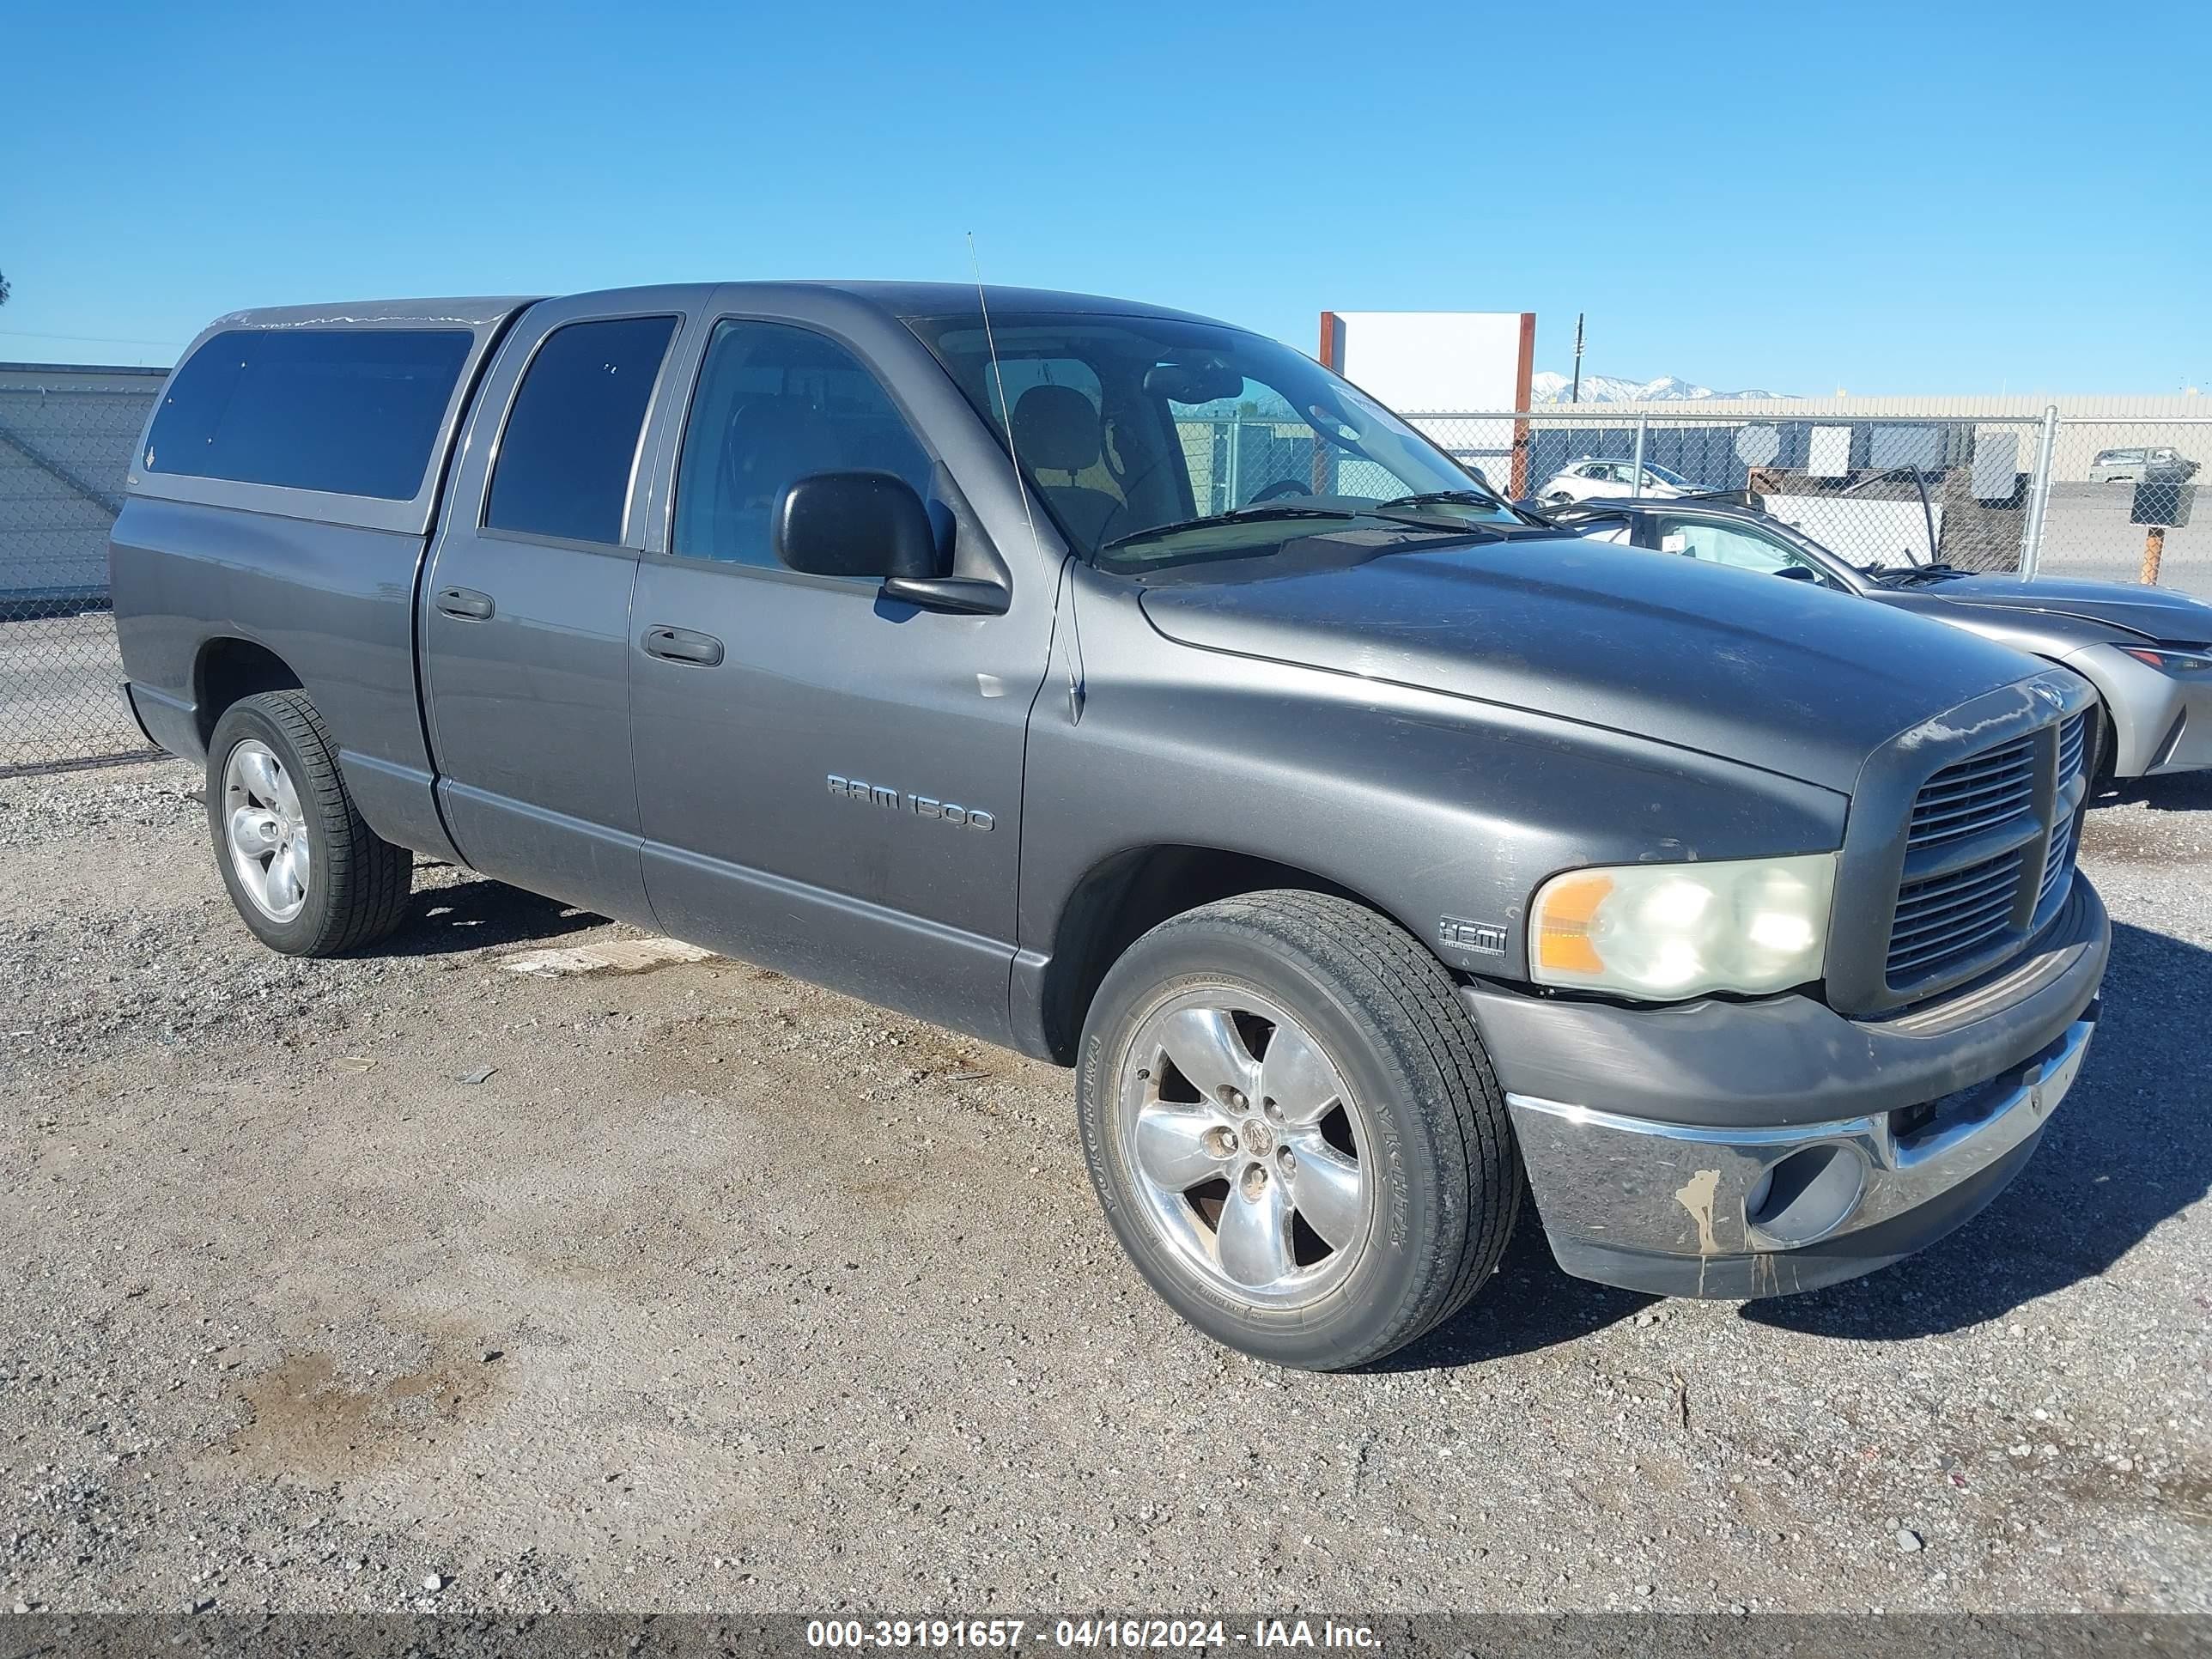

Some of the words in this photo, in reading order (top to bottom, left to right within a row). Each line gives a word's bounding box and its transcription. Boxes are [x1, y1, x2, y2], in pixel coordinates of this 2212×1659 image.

[826, 774, 900, 811] RAM
[908, 793, 995, 831] 1500
[1439, 921, 1506, 951] HEMI
[1083, 1035, 1117, 1211] YOKOHAMA
